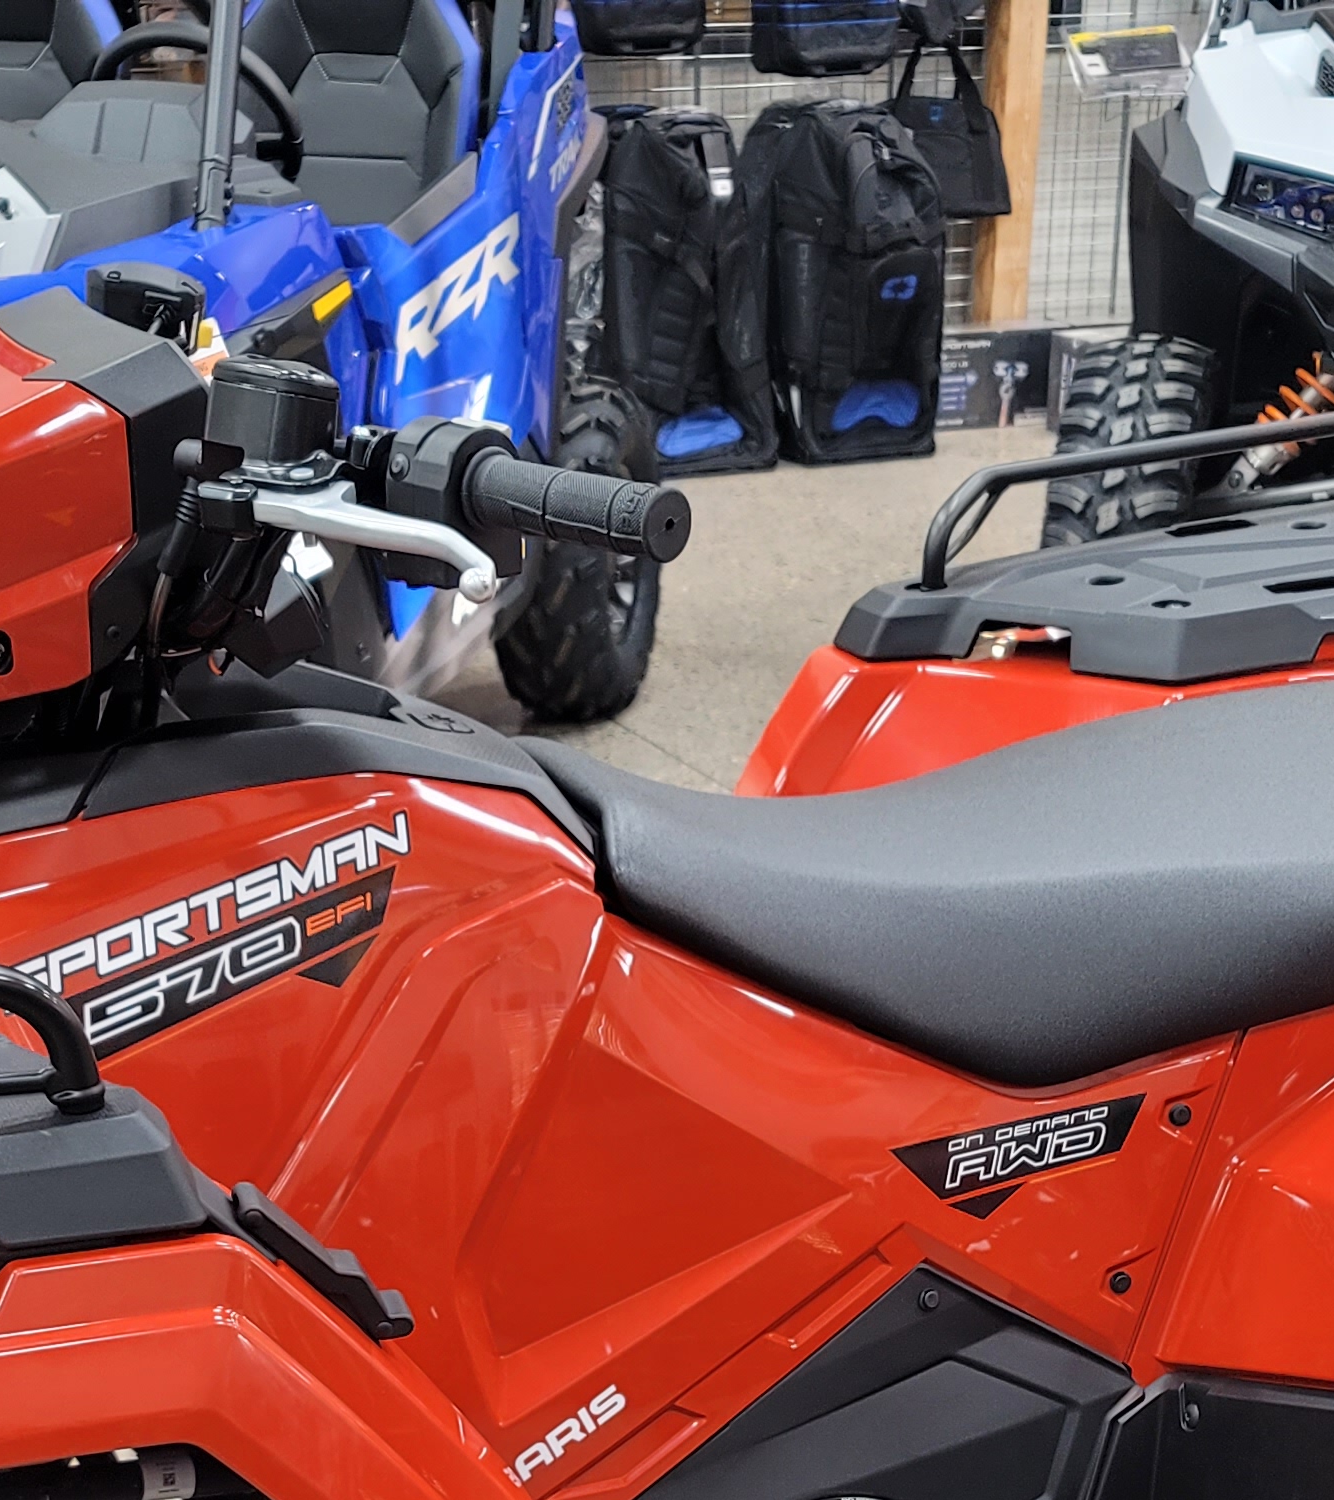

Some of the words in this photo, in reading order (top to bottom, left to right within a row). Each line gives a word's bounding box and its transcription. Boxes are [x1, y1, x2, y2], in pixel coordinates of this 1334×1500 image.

[395, 211, 520, 385] RZR
[83, 915, 303, 1046] 570
[306, 891, 373, 938] EFI
[944, 1121, 1107, 1189] AWD
[948, 1133, 984, 1152] ON
[995, 1105, 1109, 1142] DEMAND
[513, 1383, 627, 1483] ARIS
